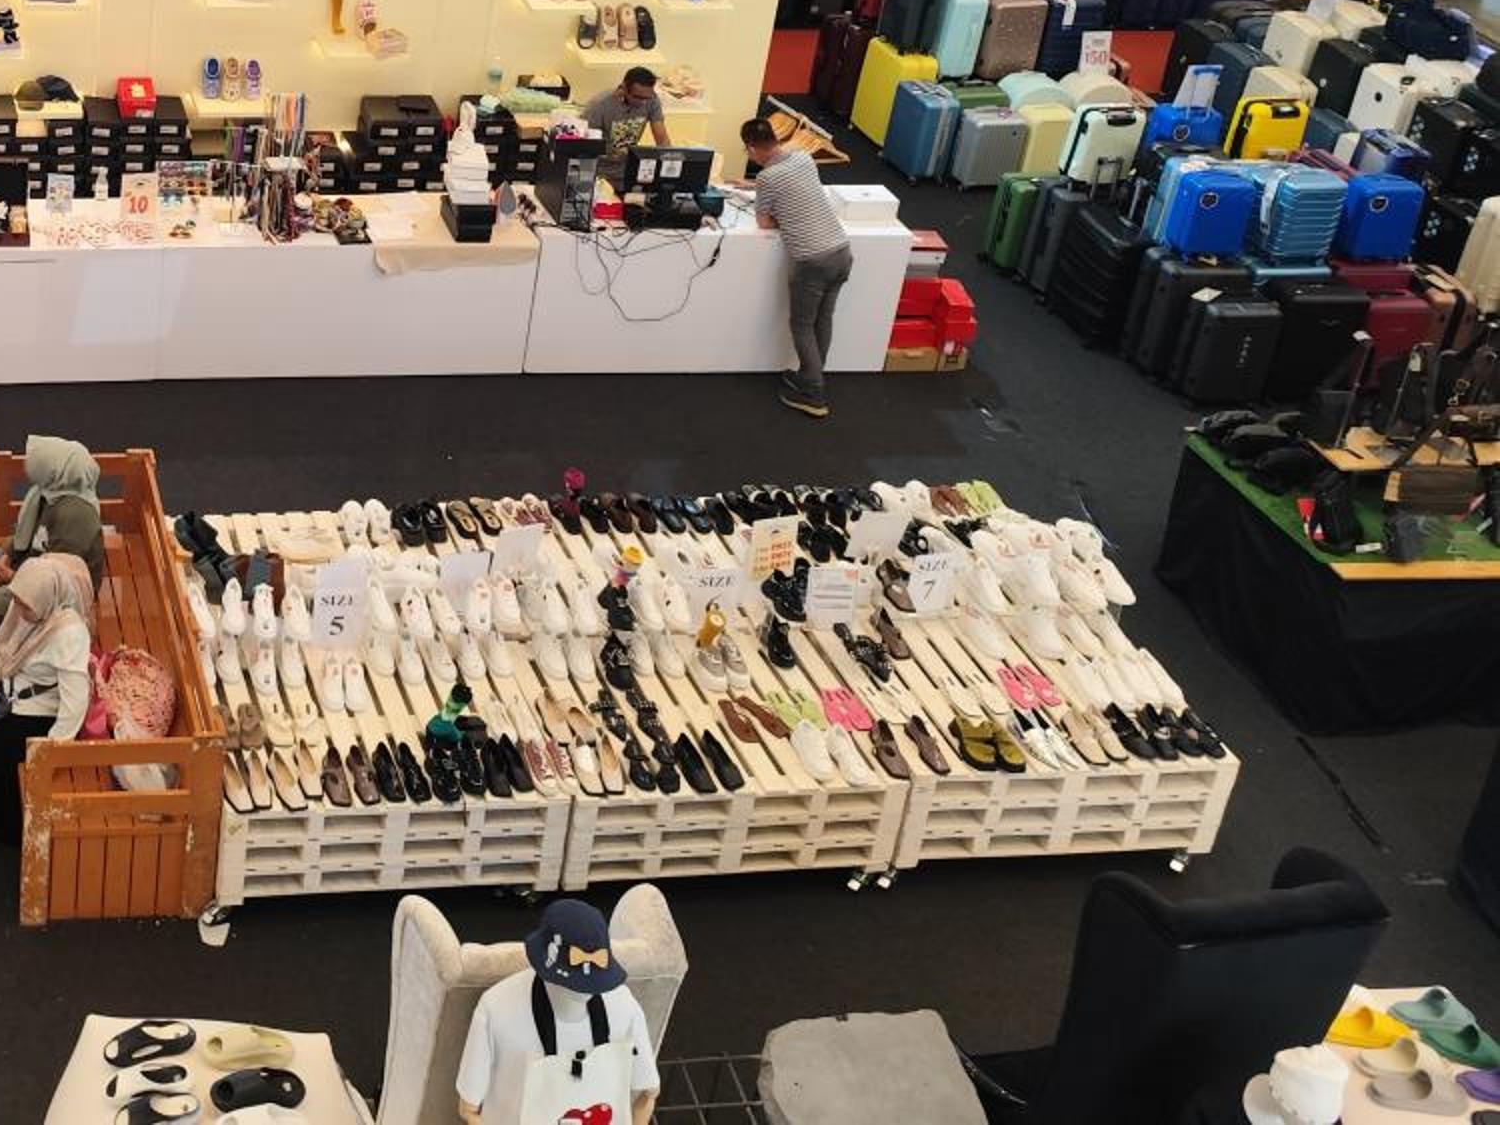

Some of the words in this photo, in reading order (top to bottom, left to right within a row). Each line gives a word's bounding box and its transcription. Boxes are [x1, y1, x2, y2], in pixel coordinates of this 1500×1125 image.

[130, 195, 148, 213] 10
[699, 575, 735, 587] SIZE
[923, 580, 936, 601] 7
[320, 595, 355, 606] SIZE
[329, 616, 345, 636] 5
